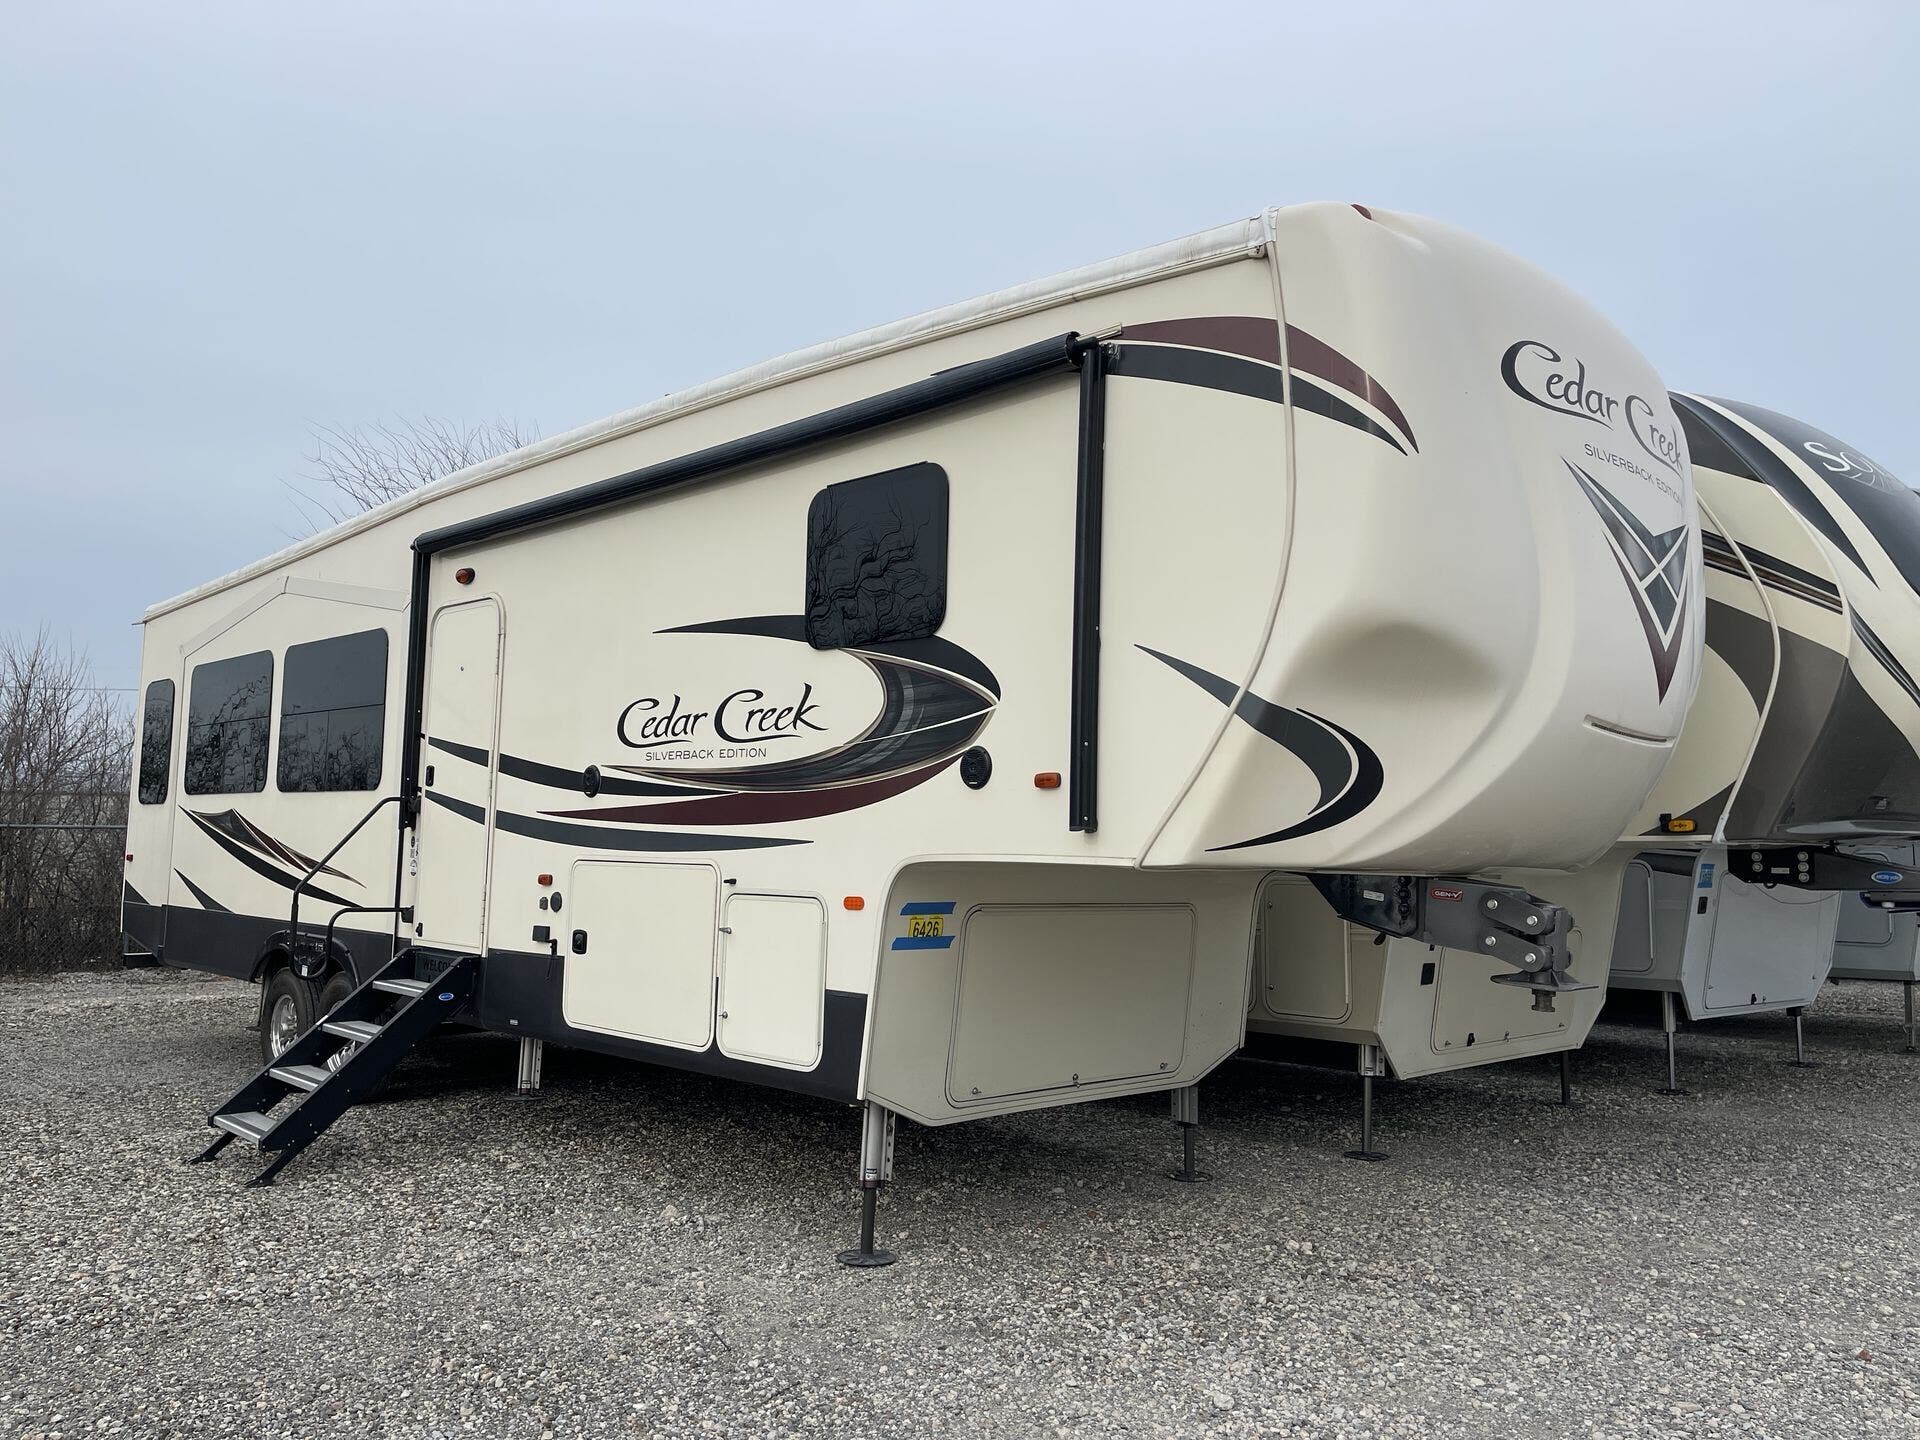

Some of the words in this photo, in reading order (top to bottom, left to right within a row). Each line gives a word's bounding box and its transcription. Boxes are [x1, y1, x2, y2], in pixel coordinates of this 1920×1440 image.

[1501, 340, 1619, 431] Cedar
[1624, 395, 1683, 480] Creek
[1584, 443, 1654, 485] SILVERBACK
[617, 693, 708, 748] Cedar
[714, 683, 830, 743] Creek
[645, 749, 714, 762] SILVERBACK
[719, 747, 767, 759] EDITION
[912, 920, 940, 938] 6426
